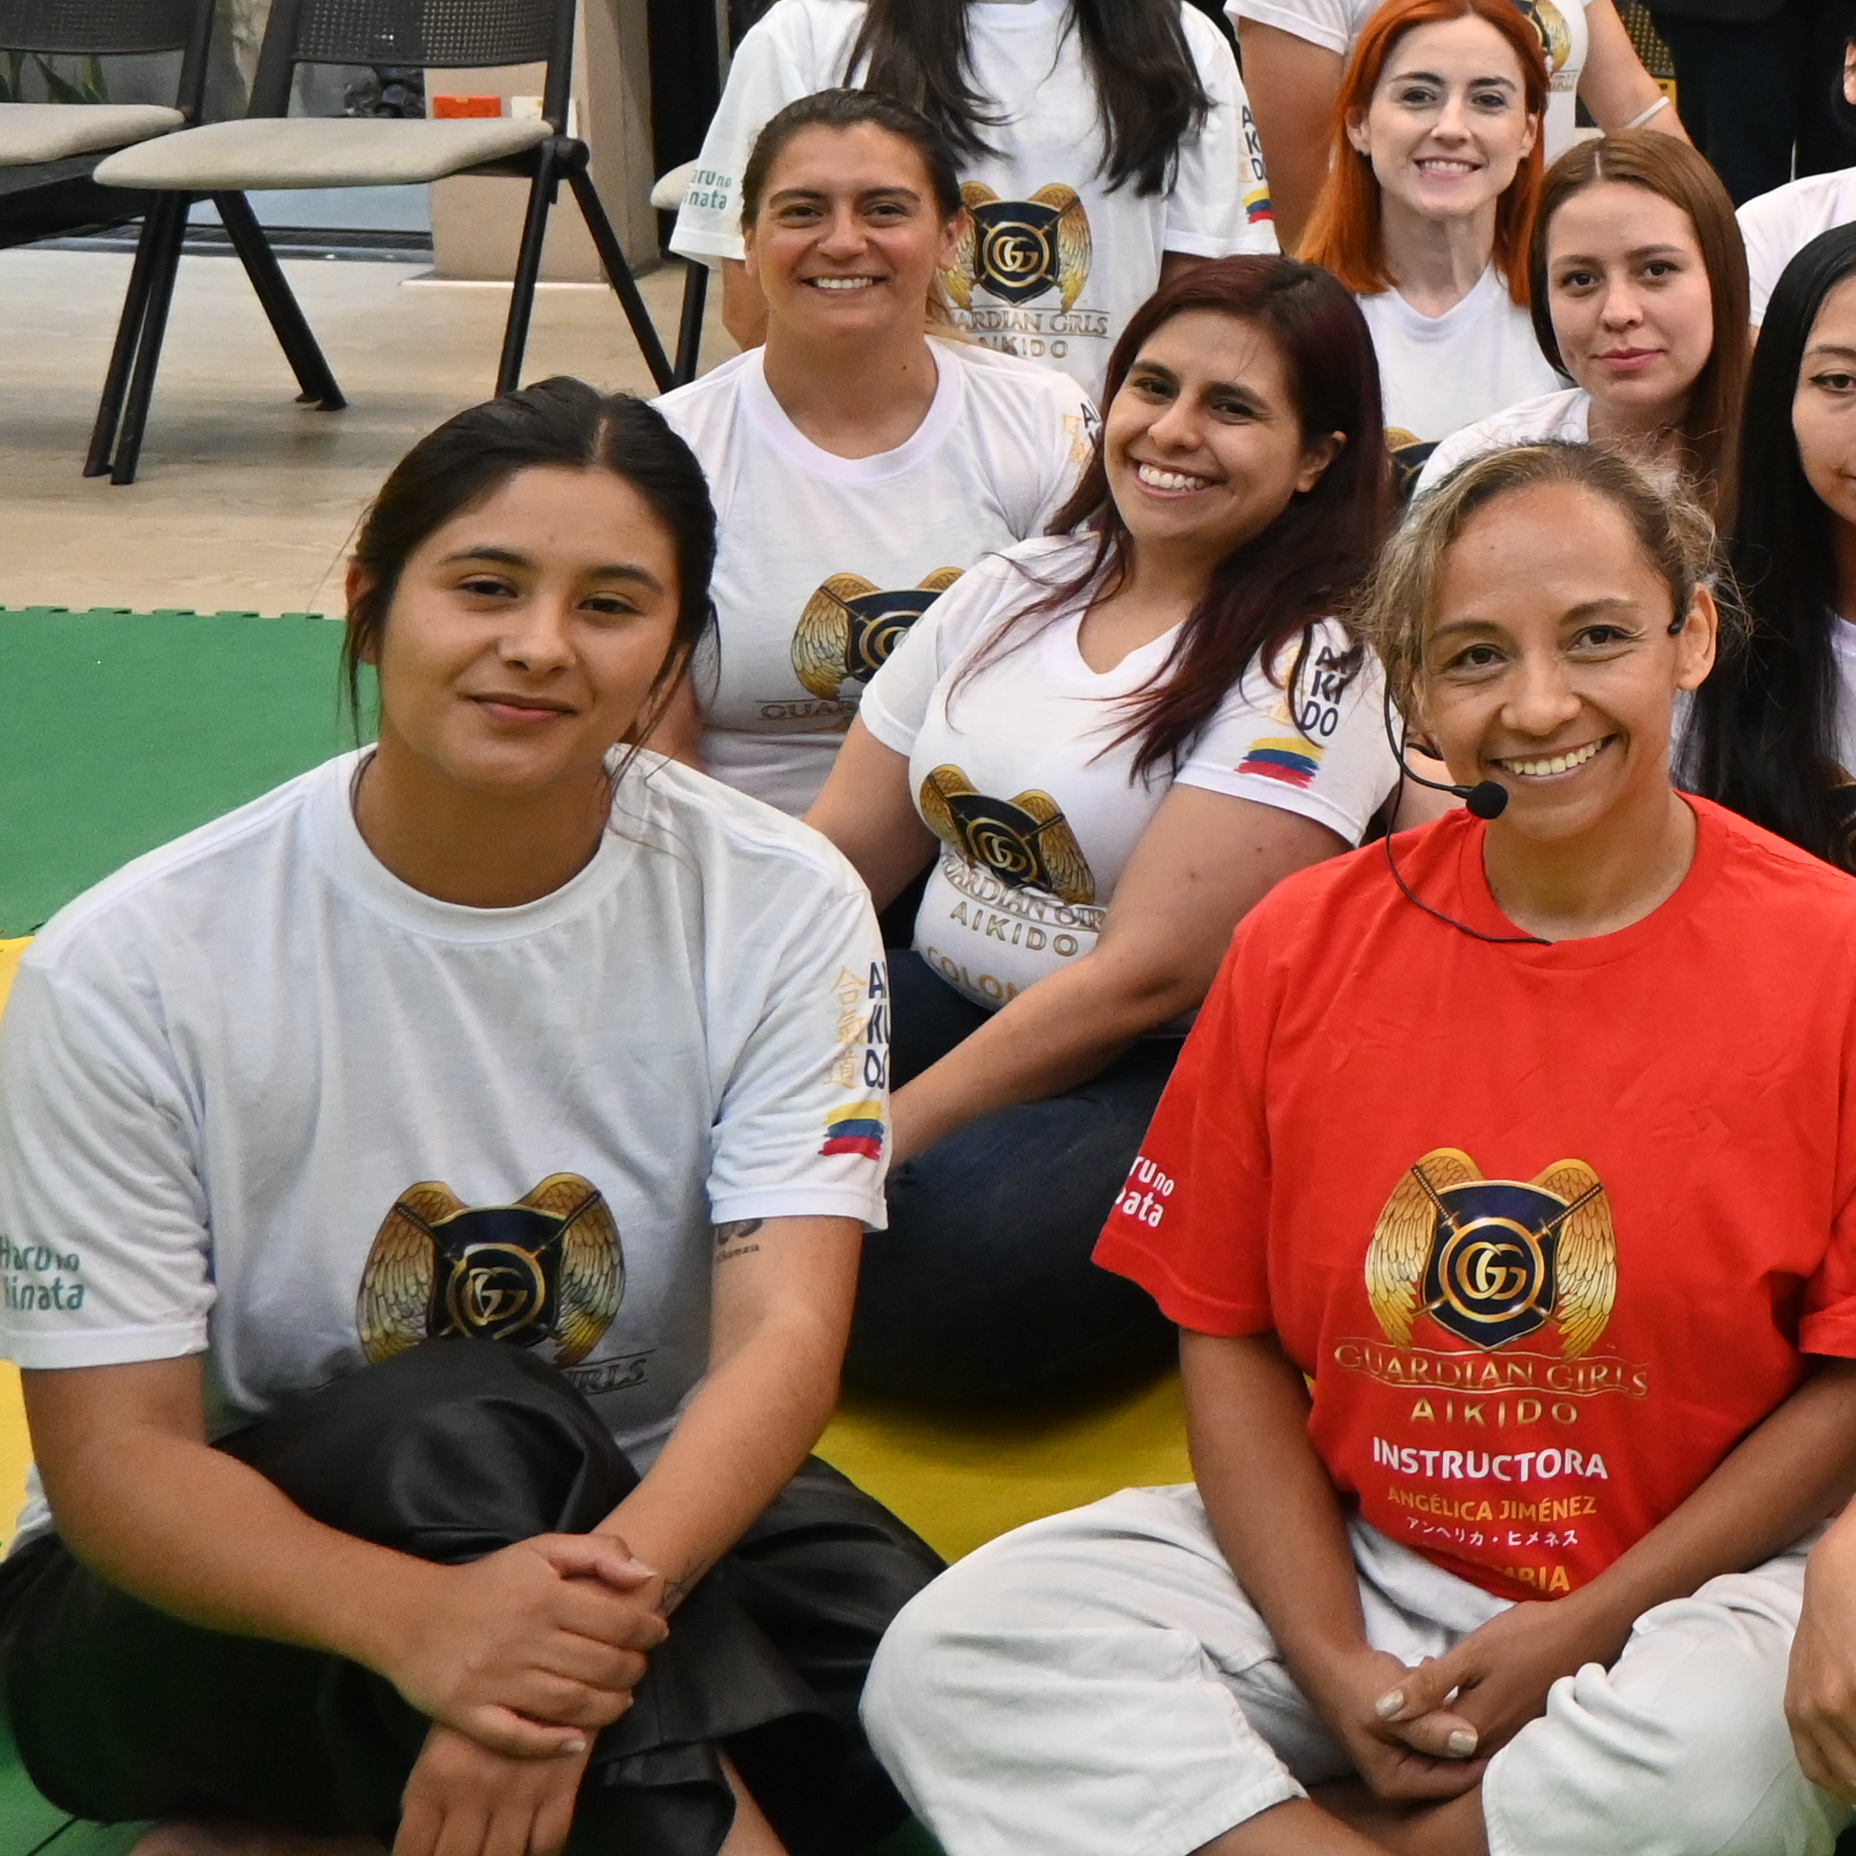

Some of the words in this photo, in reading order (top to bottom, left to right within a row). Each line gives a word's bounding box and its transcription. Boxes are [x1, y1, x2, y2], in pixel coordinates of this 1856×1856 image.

[1299, 700, 1339, 737] DO
[950, 901, 1078, 957] AIKIDO
[1334, 1344, 1533, 1389] GUARDIAN
[1546, 1363, 1649, 1398] GIRLS
[1410, 1396, 1579, 1428] AIKIDO
[1373, 1436, 1609, 1483] INSTRUCTORA
[1387, 1486, 1493, 1522] ANGÉLICA
[1499, 1495, 1598, 1523] JIMÉNEZ
